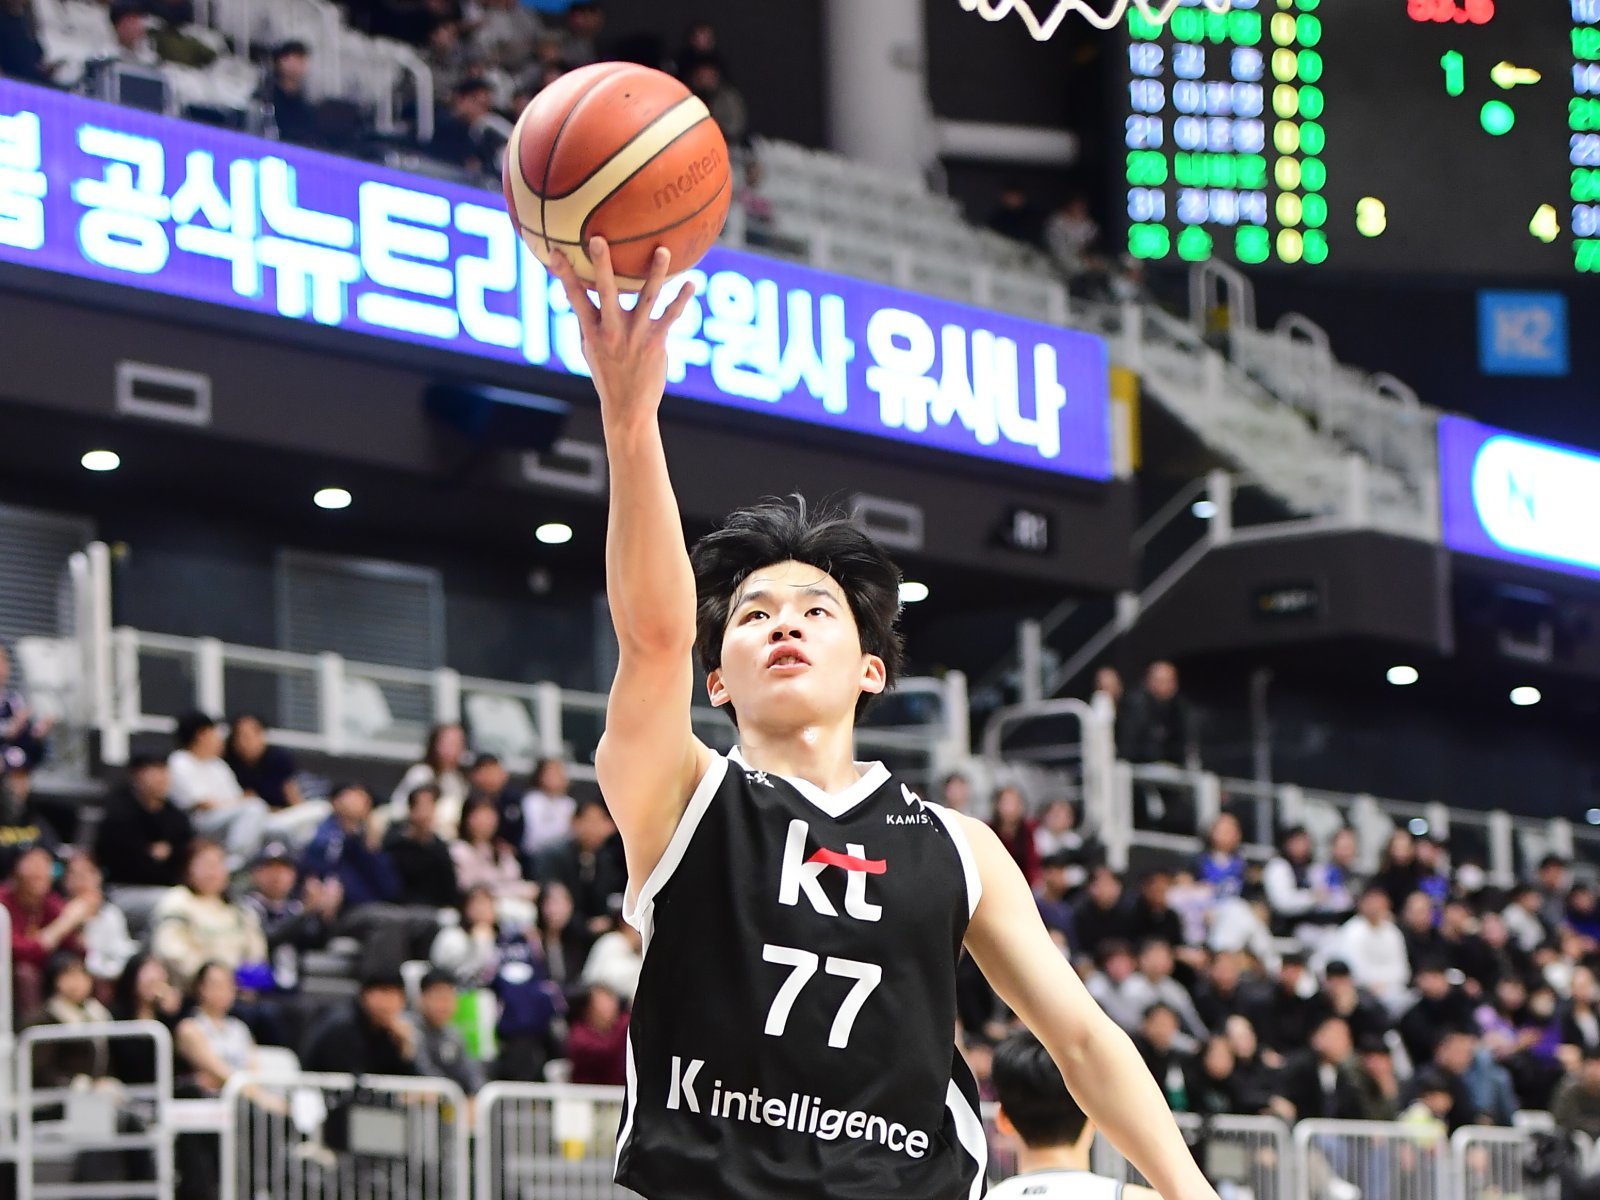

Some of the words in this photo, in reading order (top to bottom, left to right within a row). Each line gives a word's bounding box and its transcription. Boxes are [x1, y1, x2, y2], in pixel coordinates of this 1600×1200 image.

[653, 147, 721, 209] molten
[778, 818, 887, 922] kt
[886, 814, 939, 832] KAMIS
[762, 943, 882, 1049] 77
[666, 1056, 705, 1113] K
[710, 1079, 929, 1159] intelligence
